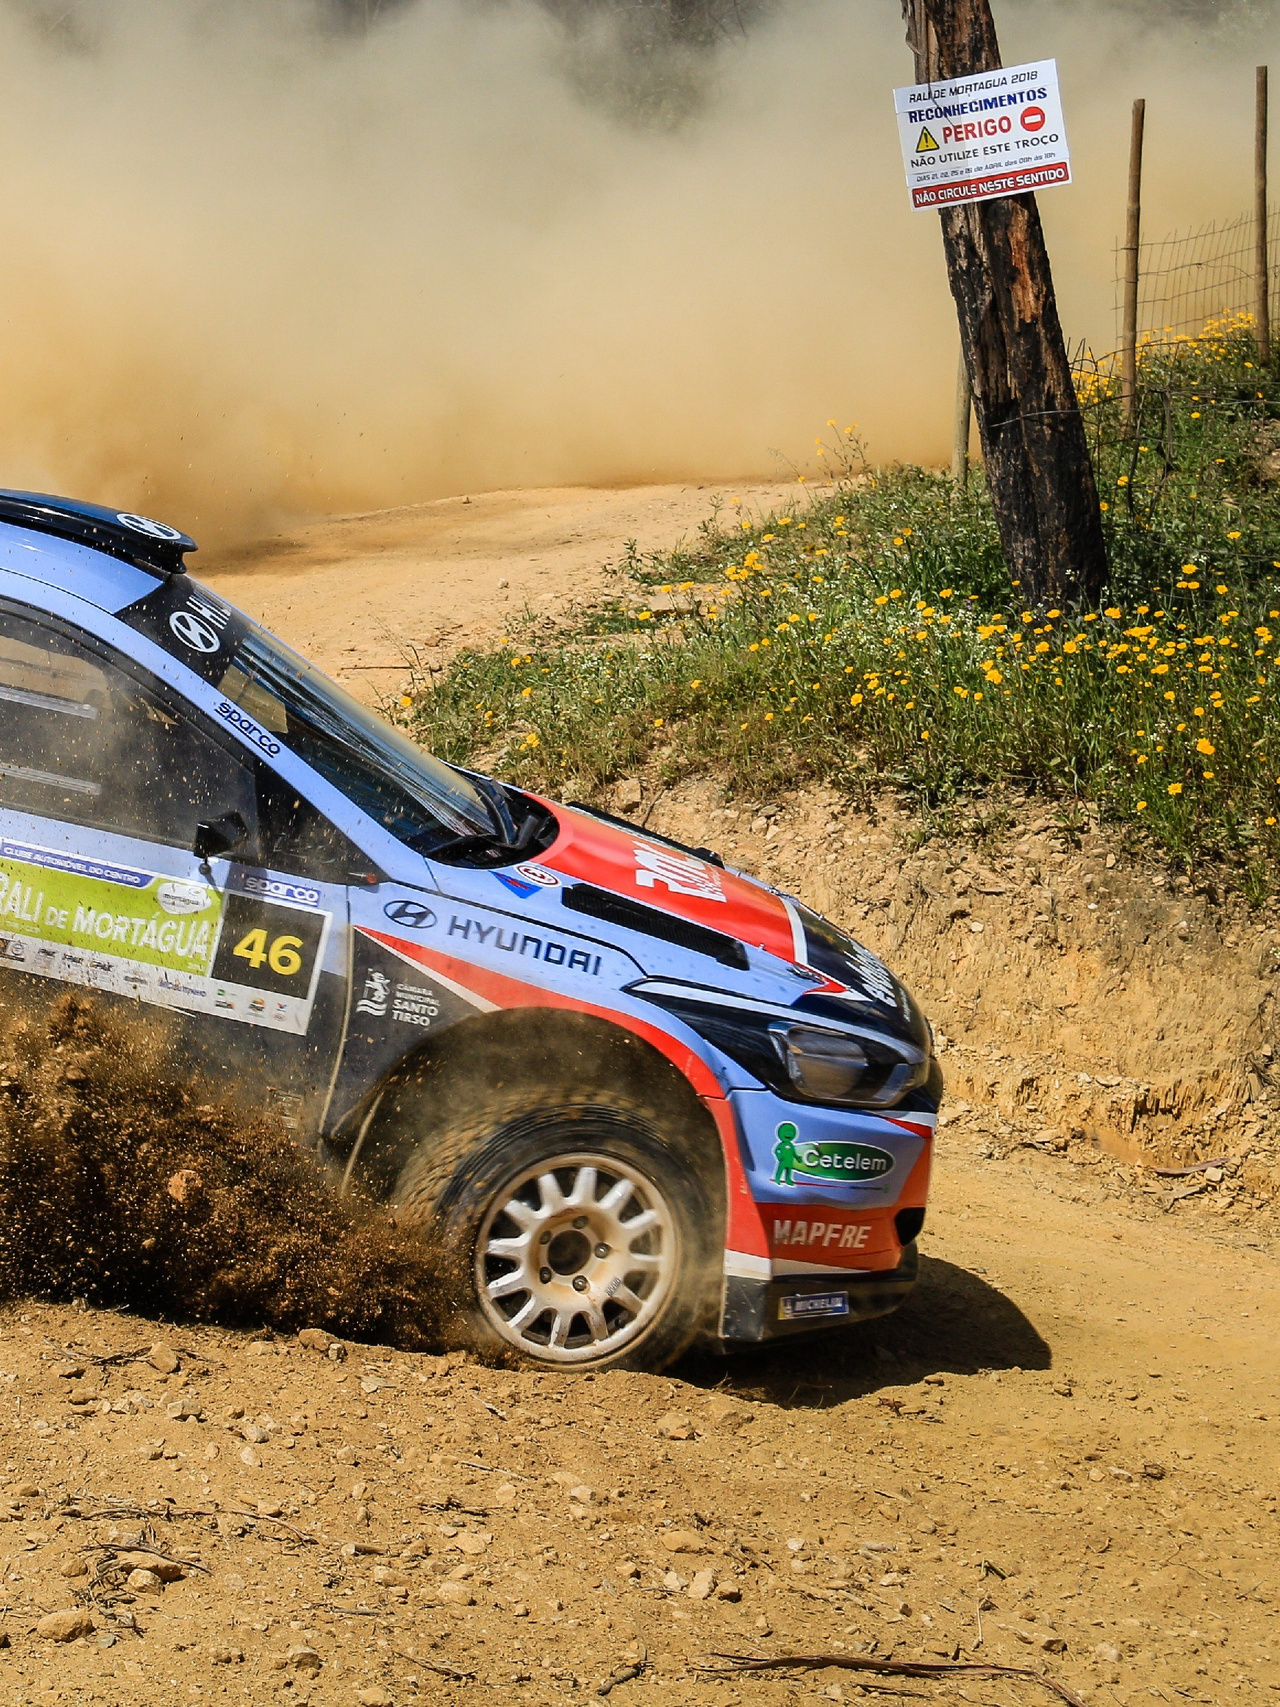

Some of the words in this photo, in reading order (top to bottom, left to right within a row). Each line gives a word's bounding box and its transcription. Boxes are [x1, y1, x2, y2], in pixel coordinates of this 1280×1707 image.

[909, 91, 933, 103] RALI
[934, 88, 947, 99] DE
[1011, 70, 1039, 84] 2018
[908, 87, 1048, 123] RECONHECIMENTOS
[942, 115, 1012, 144] PERIGO
[910, 153, 936, 168] NÃO
[939, 148, 980, 165] UTILIZE
[983, 142, 1011, 156] ESTE
[1014, 132, 1060, 150] TROÇO
[914, 191, 937, 204] NÃO
[937, 185, 978, 200] CIRCULE
[979, 178, 1015, 193] NESTE
[1016, 168, 1066, 186] SENTIDO
[216, 701, 281, 758] sparco
[245, 875, 320, 902] sparco
[45, 905, 69, 930] DE
[72, 904, 211, 962] MORTÁGUA
[448, 914, 603, 976] HYUNDAI
[232, 927, 305, 977] 46
[391, 1009, 431, 1027] TIRSO
[392, 999, 439, 1017] SANTO
[801, 1149, 888, 1172] Cetelem
[773, 1219, 872, 1249] MAPFRE
